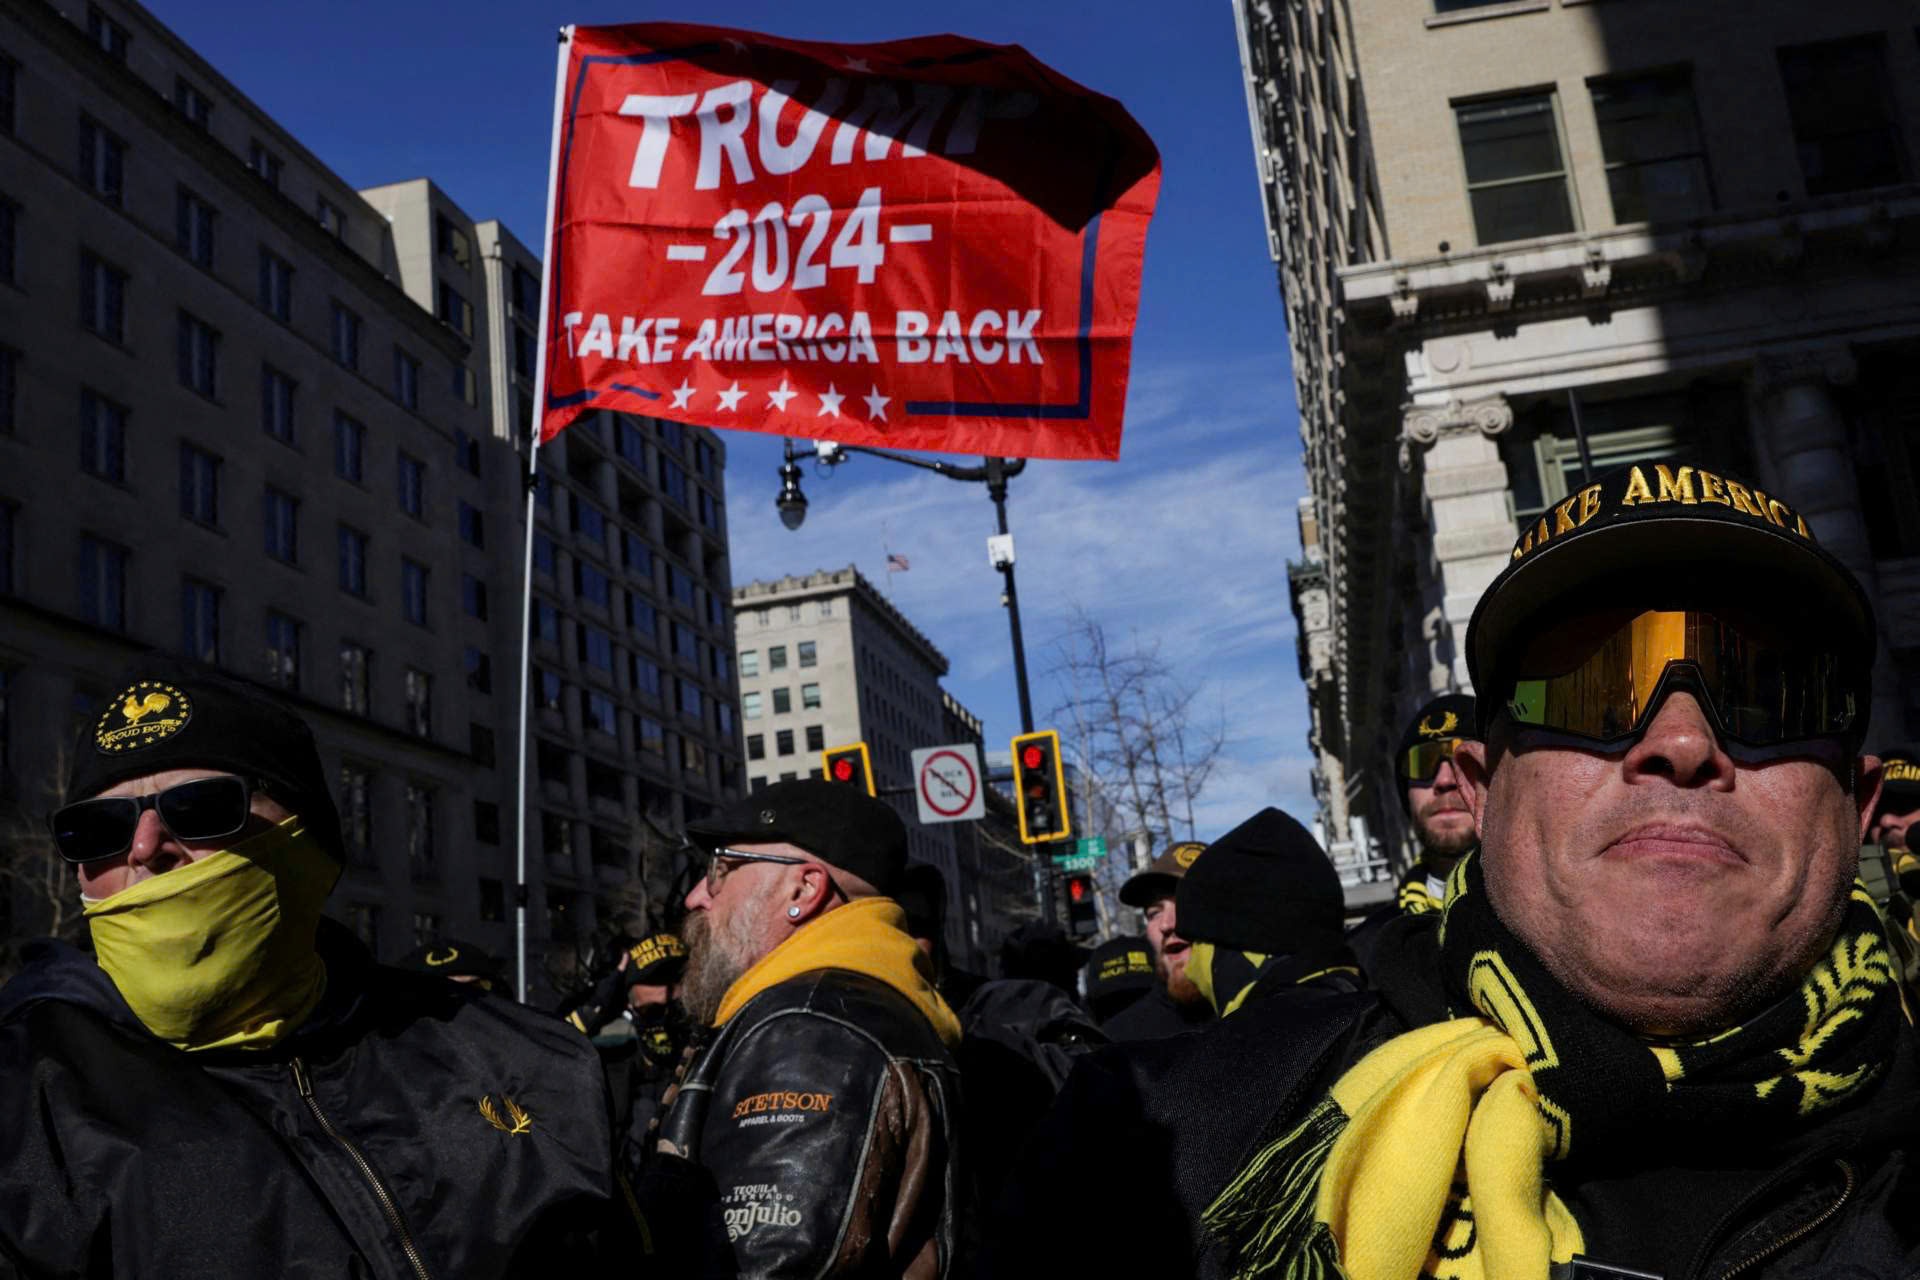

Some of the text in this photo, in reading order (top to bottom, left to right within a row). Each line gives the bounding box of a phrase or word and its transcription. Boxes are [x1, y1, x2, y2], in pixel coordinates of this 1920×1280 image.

[618, 78, 1040, 190] TRUMP
[564, 309, 1044, 365] TAKE AMERICA BACK
[731, 1091, 833, 1119] STETSON
[738, 1115, 769, 1128] APPAREL
[776, 1114, 805, 1123] BOOTS
[733, 1184, 779, 1196] TEQUILA
